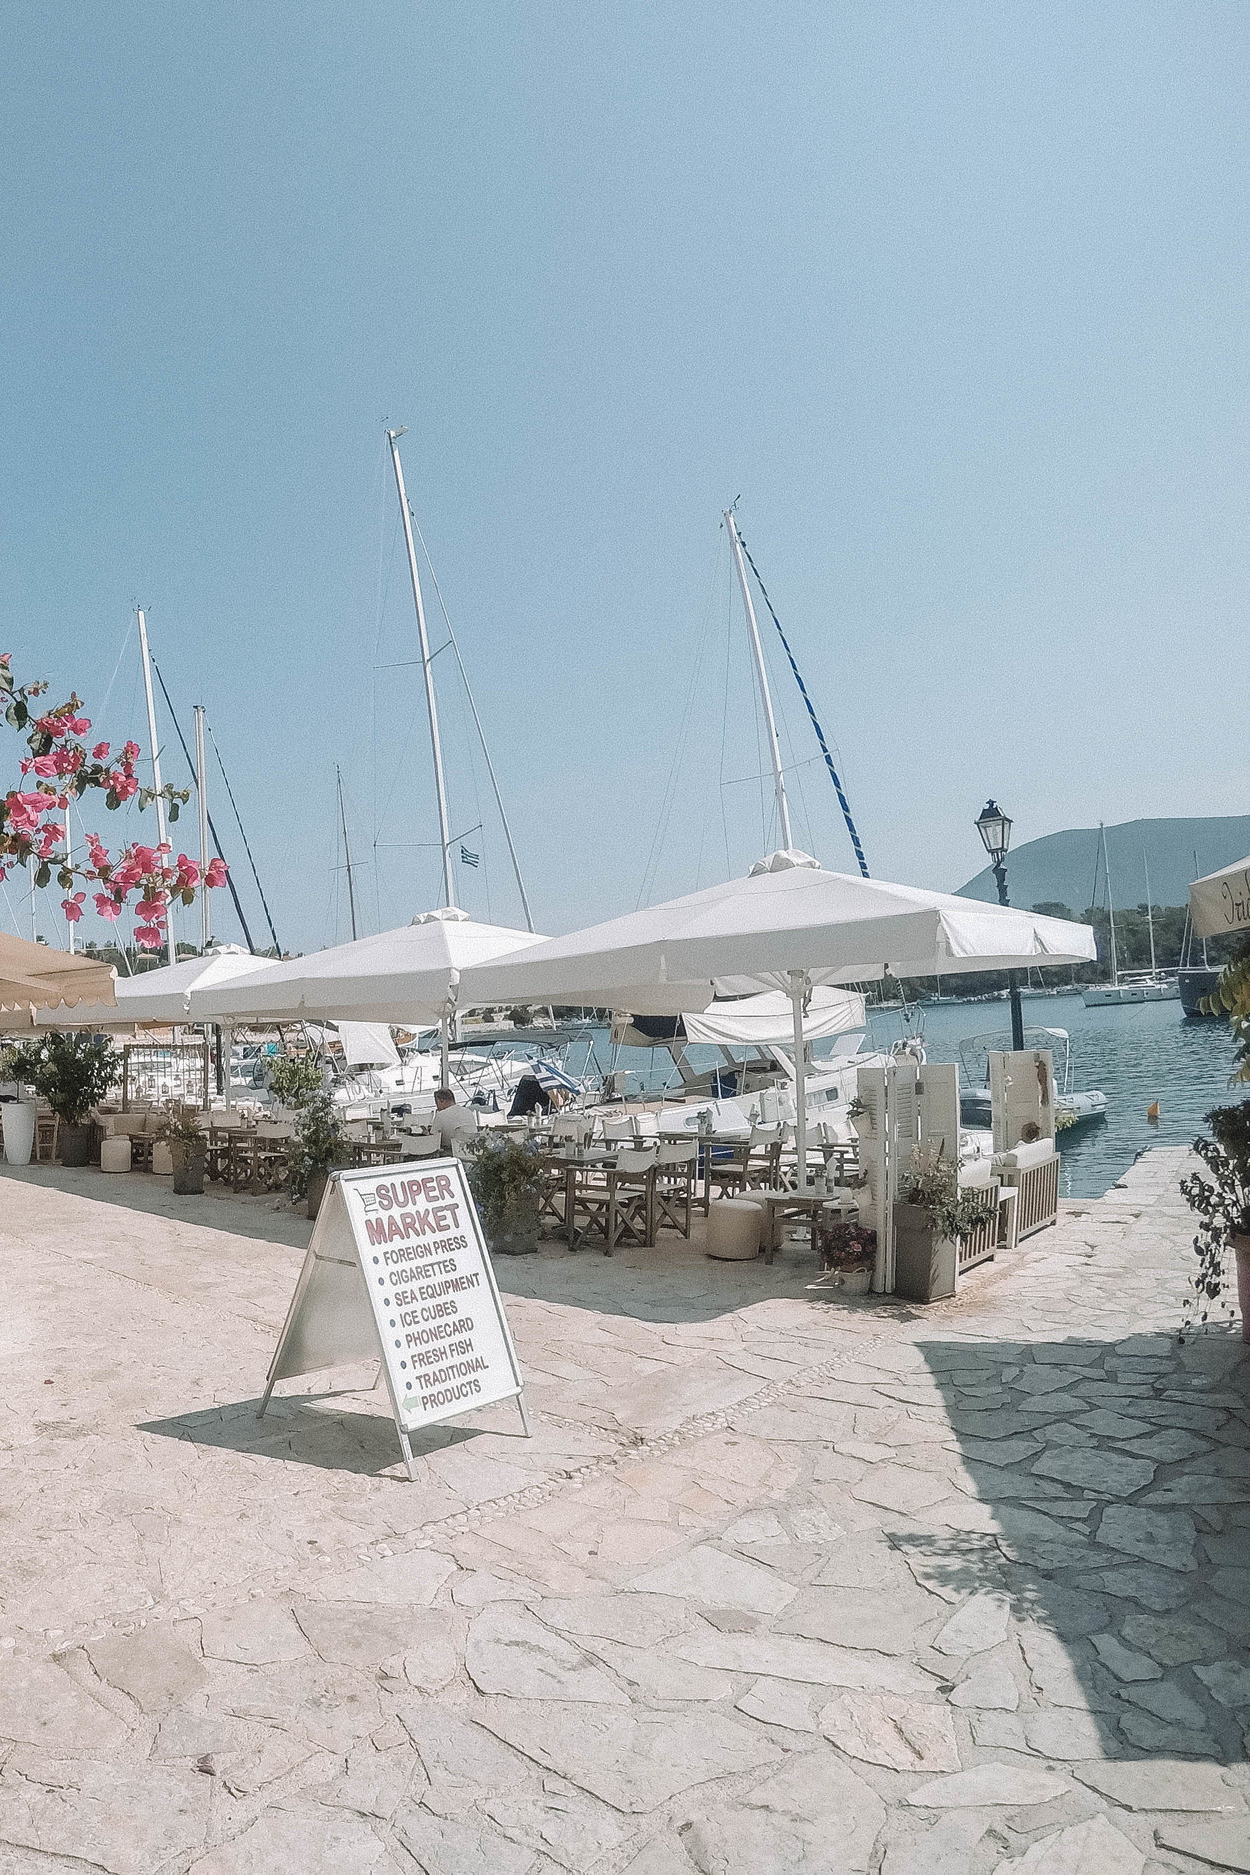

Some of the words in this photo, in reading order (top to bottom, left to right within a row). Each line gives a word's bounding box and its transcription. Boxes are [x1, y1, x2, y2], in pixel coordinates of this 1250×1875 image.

[375, 1174, 455, 1211] SUPER
[364, 1202, 460, 1246] MARKET
[383, 1242, 433, 1266] FOREIGN
[433, 1235, 468, 1255] PRESS
[389, 1257, 457, 1286] CIGARETTES
[394, 1289, 418, 1307] SEA
[419, 1272, 480, 1301] EQUIPMENT
[399, 1310, 420, 1328] ICE
[420, 1299, 458, 1322] CUBES
[405, 1316, 475, 1349] PHONECARD
[411, 1345, 449, 1370] FRESH
[448, 1337, 474, 1359] FISH
[415, 1355, 490, 1390] TRADITIONAL
[421, 1379, 482, 1411] PRODUCTS
